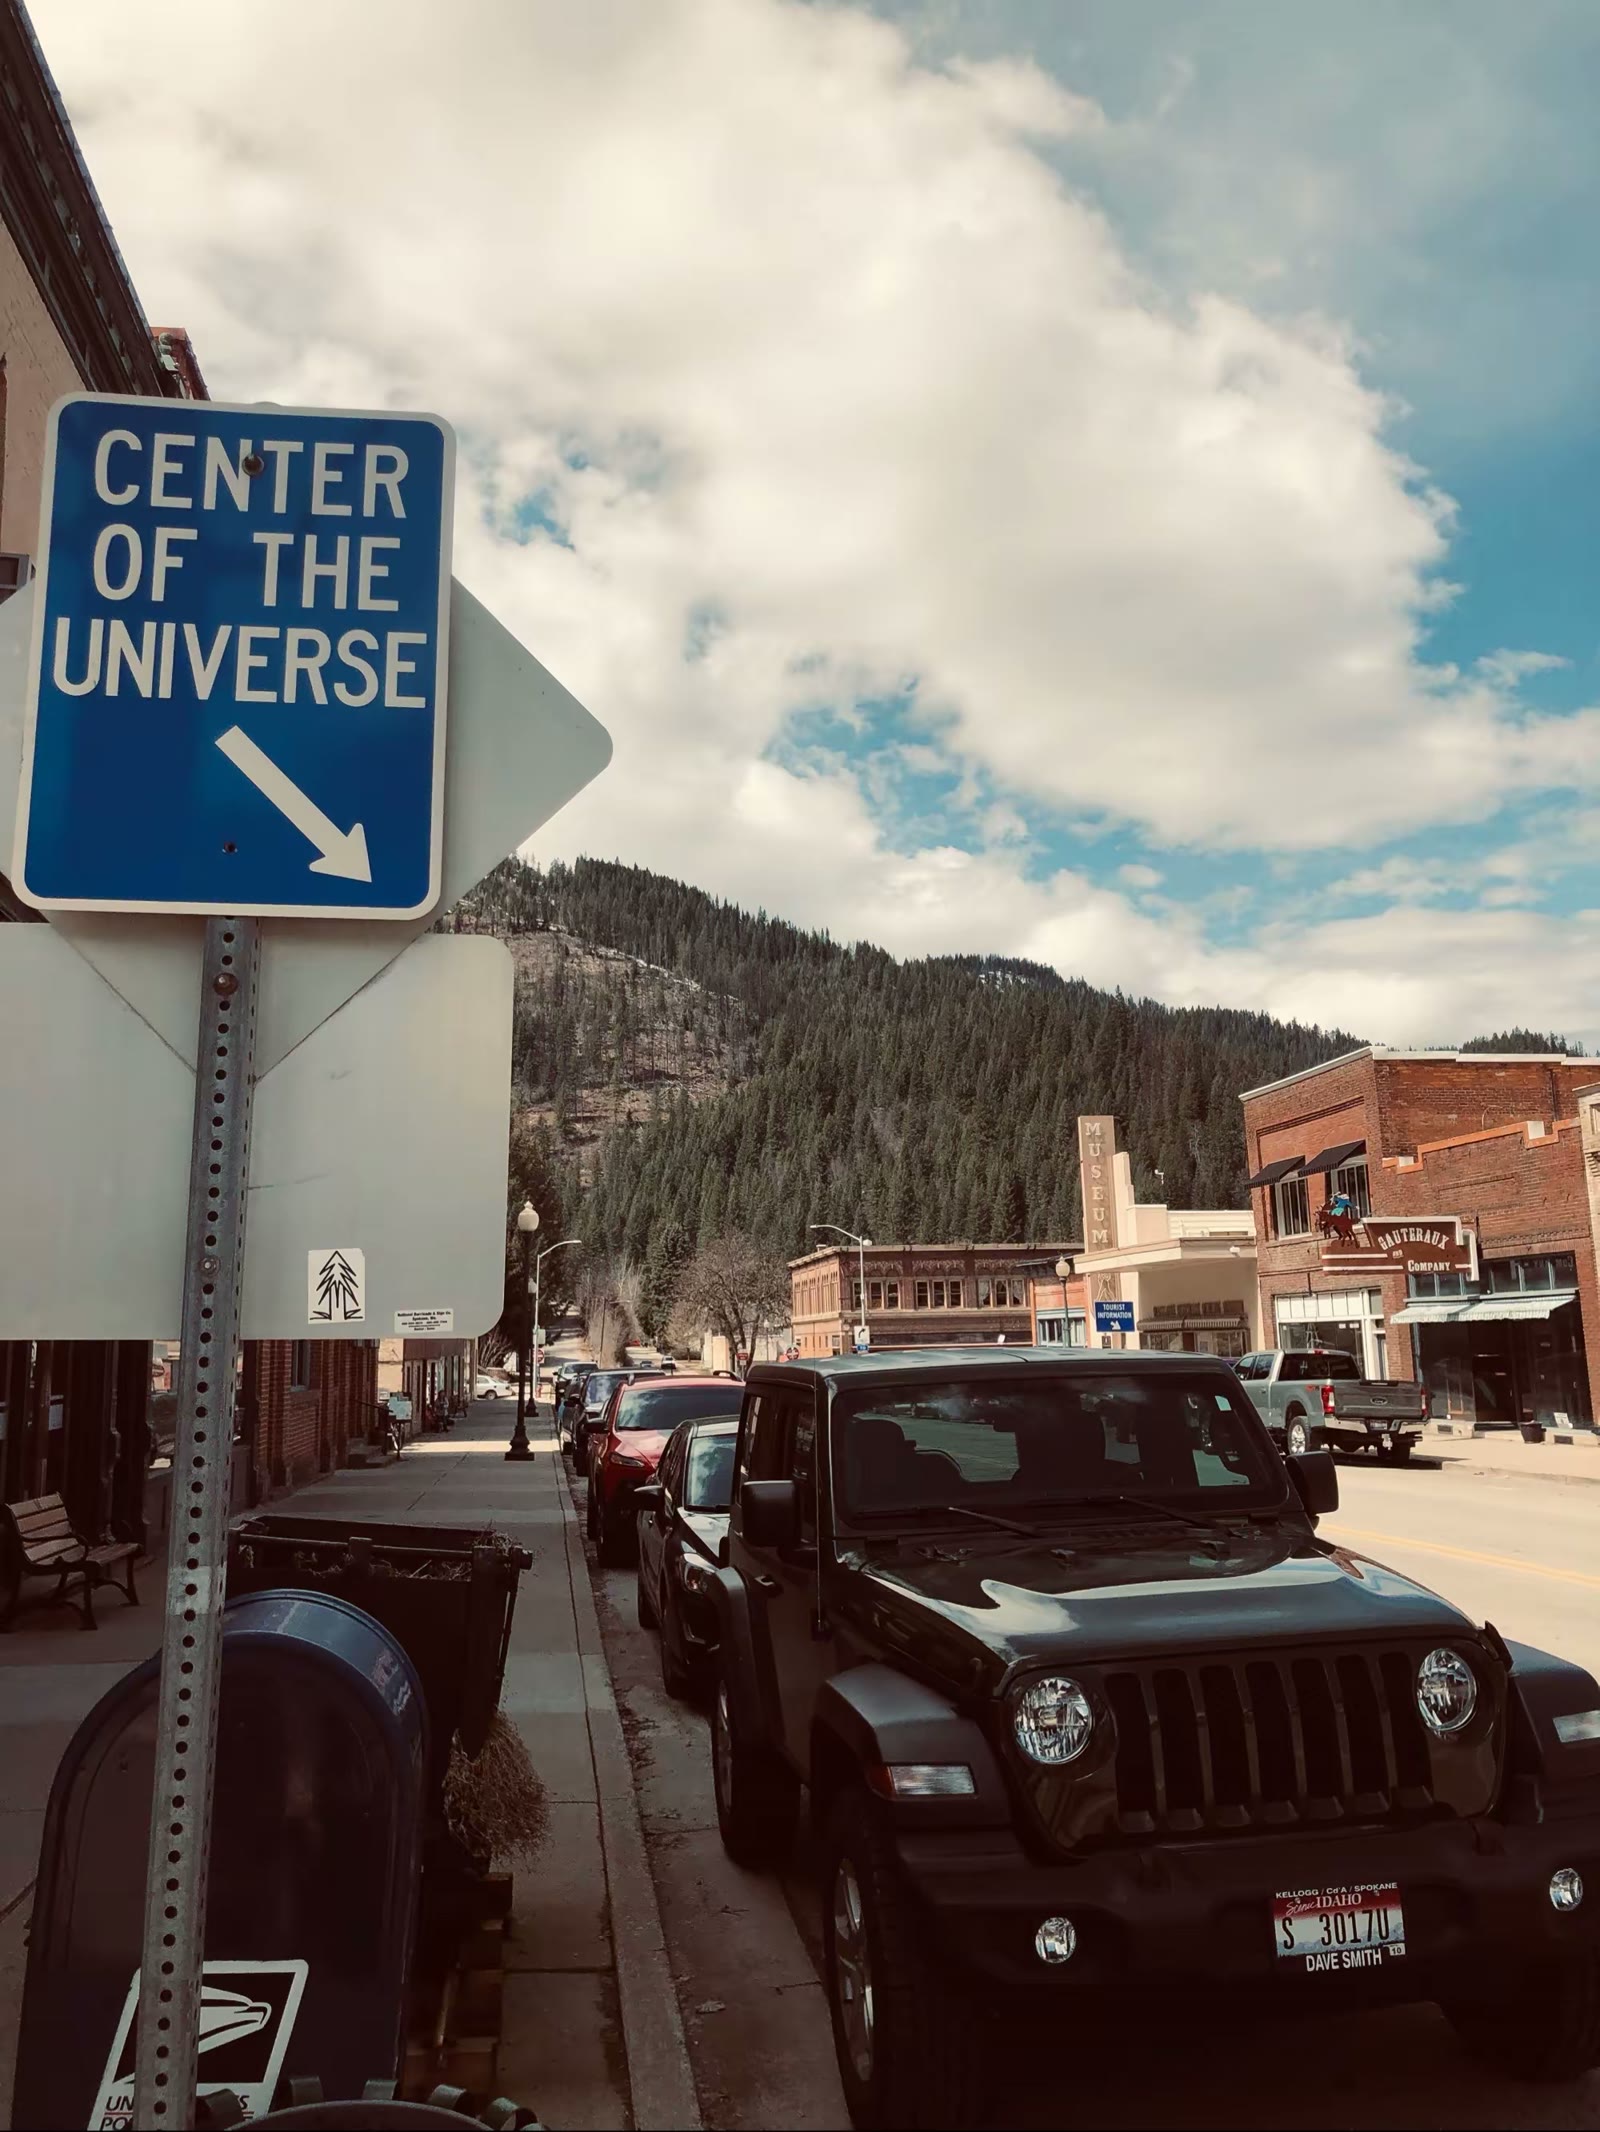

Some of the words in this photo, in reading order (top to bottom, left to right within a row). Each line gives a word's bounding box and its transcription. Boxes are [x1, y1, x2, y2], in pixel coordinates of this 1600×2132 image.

[95, 429, 409, 519] CENTER
[93, 523, 198, 602] OF
[253, 532, 401, 612] THE
[53, 617, 427, 708] UNIVERSE
[1085, 1122, 1108, 1244] MUSEUM
[1377, 1227, 1450, 1251] GAUTERAUX
[1097, 1311, 1132, 1319] INFORMATION
[1103, 1303, 1125, 1311] TOURIST
[1275, 1889, 1319, 1899] KELLOGG
[1354, 1882, 1398, 1892] SPOKANE
[1285, 1901, 1318, 1916] Scenic
[1316, 1893, 1362, 1909] IDAHO
[1281, 1916, 1295, 1950] S
[1306, 1952, 1340, 1972] DAVE
[1342, 1948, 1383, 1969] SMITH
